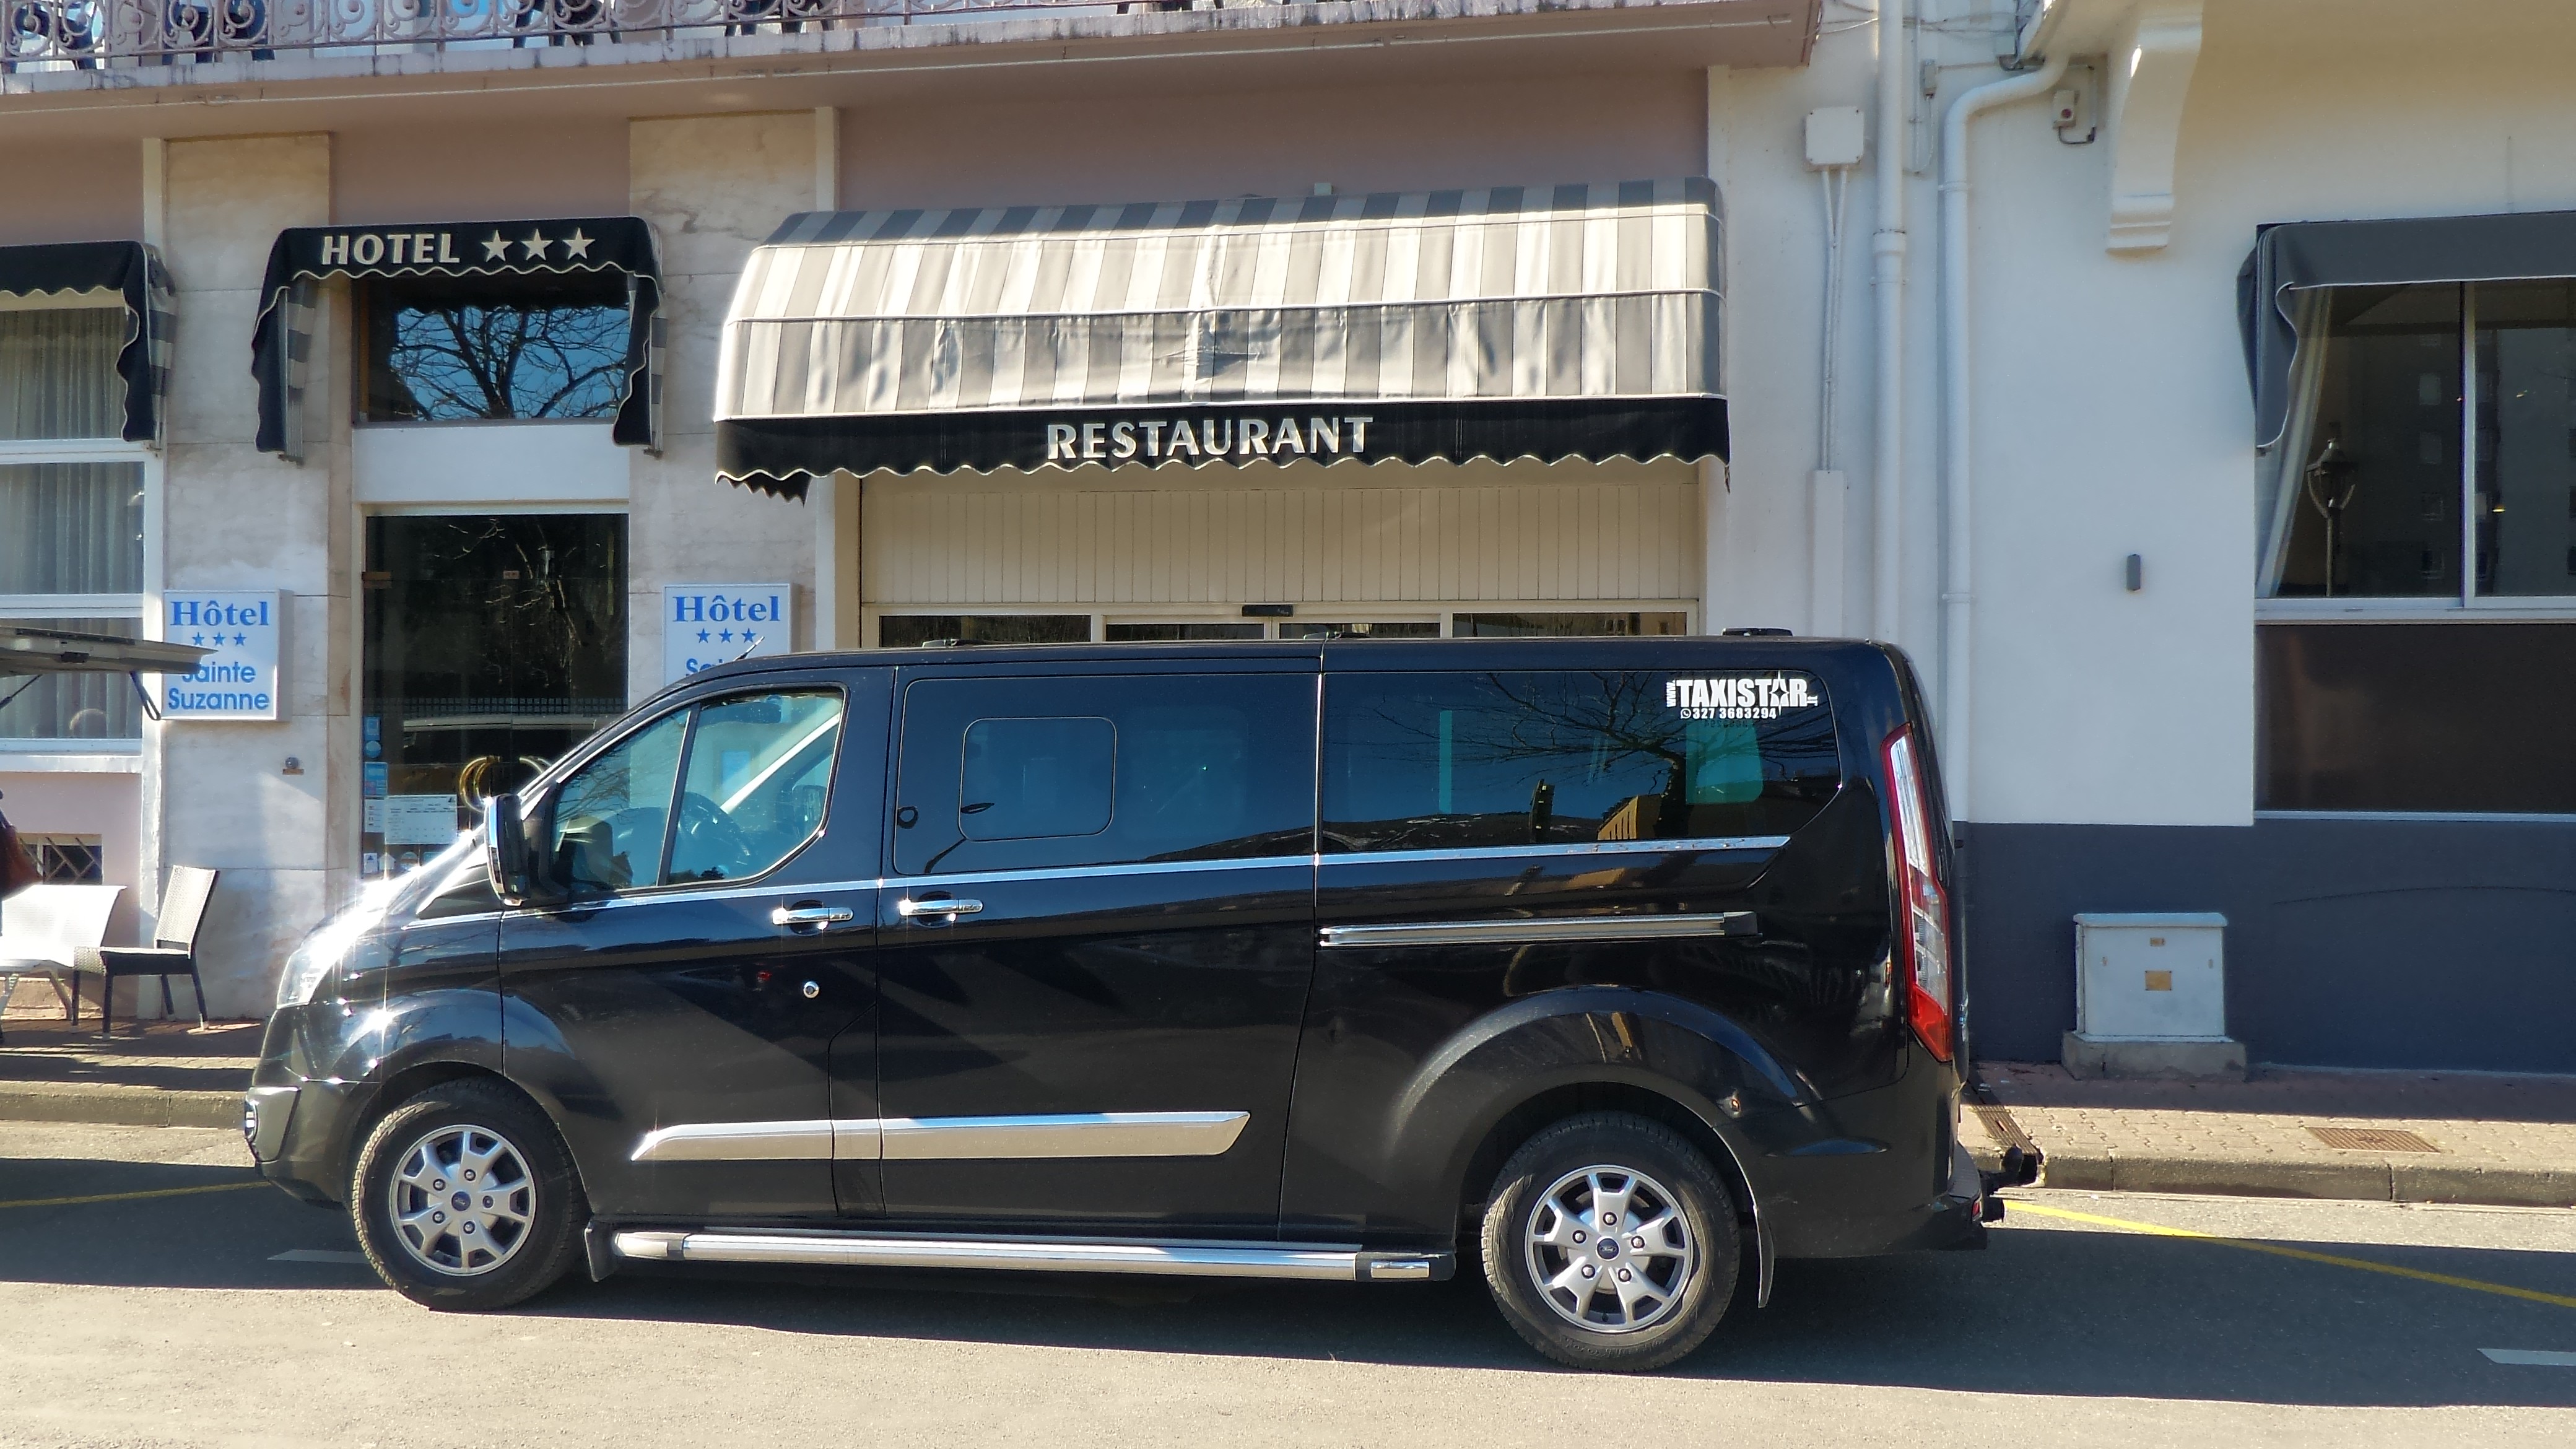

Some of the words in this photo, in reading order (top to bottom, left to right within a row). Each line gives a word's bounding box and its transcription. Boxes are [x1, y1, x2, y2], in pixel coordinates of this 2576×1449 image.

[321, 233, 460, 265] HOTEL
[1047, 417, 1373, 460] RESTAURANT
[170, 599, 269, 627] Hôtel
[672, 594, 781, 622] Hôtel
[168, 687, 270, 710] Suzanne
[1676, 679, 1808, 708] TAXISTAR
[1692, 707, 1715, 720] 327
[1719, 707, 1777, 720] 3683294
